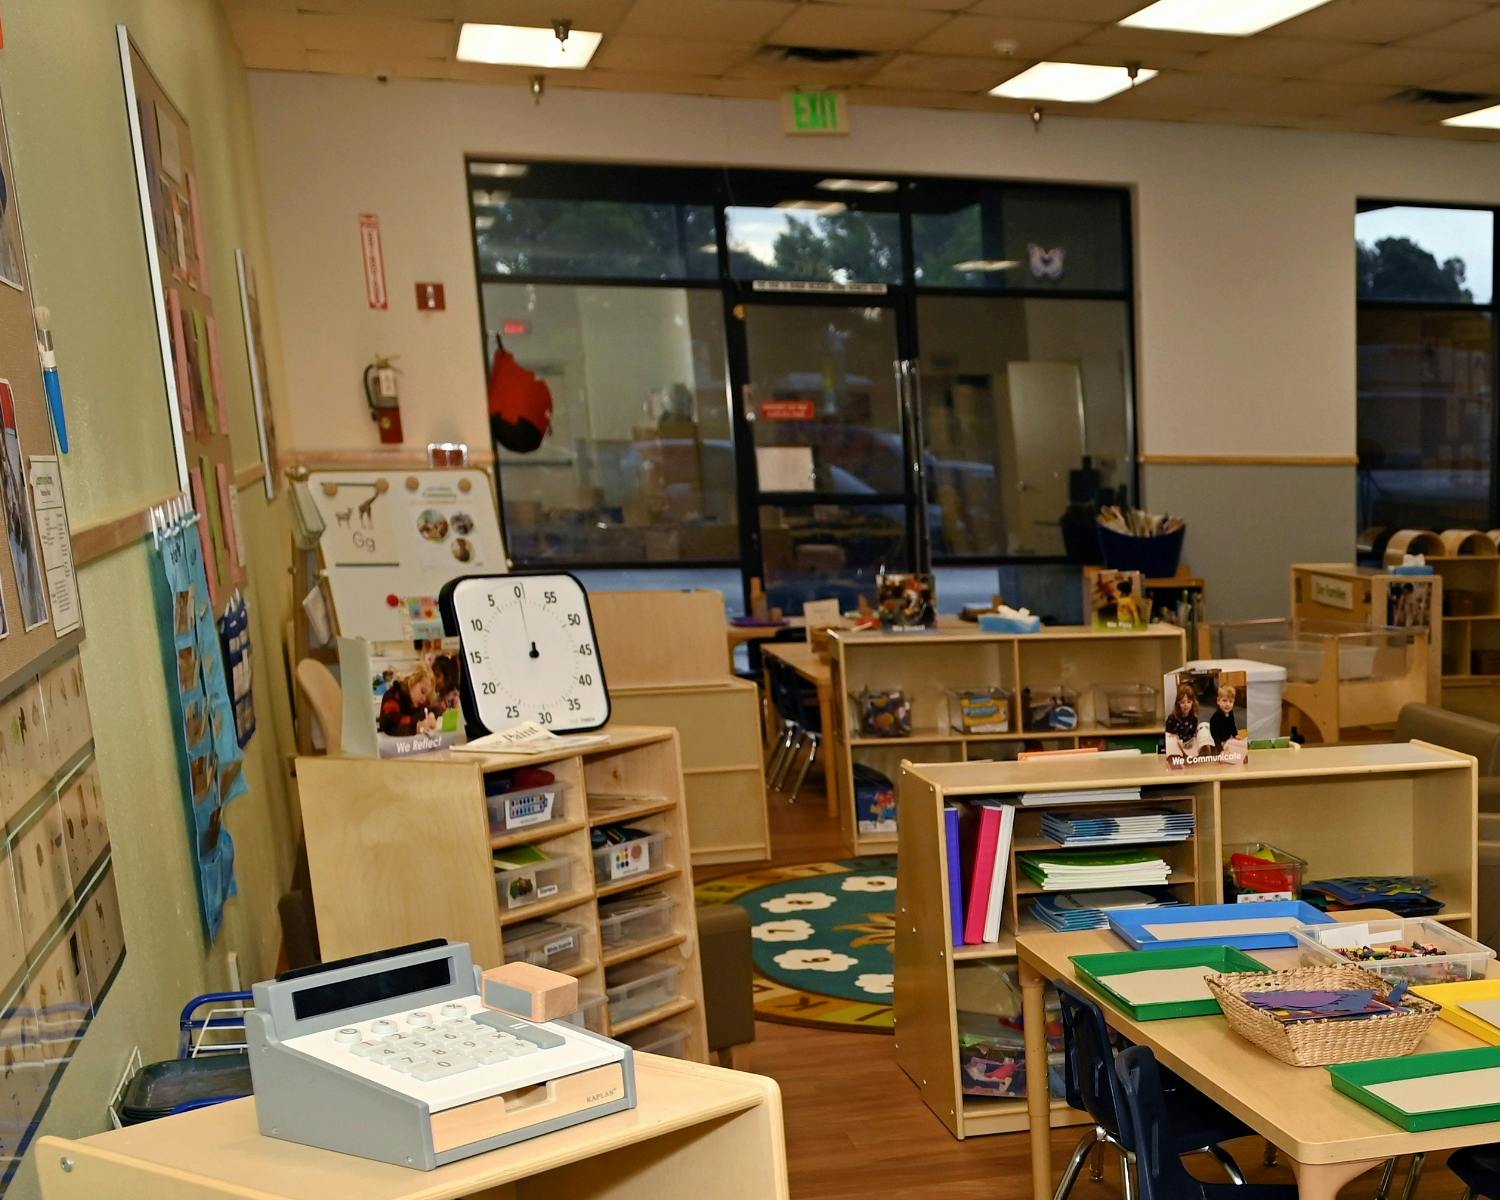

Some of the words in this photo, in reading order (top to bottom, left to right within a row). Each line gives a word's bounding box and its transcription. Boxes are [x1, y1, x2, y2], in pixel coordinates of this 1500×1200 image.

[792, 93, 838, 129] EXIT
[352, 531, 376, 553] Gg
[513, 585, 521, 599] 0
[544, 591, 557, 604] 55
[487, 594, 495, 608] 5
[470, 618, 483, 631] 10
[567, 613, 581, 626] 50
[579, 643, 592, 656] 45
[469, 651, 482, 664] 15
[578, 673, 592, 686] 40
[482, 682, 496, 695] 20
[567, 698, 581, 711] 35
[505, 705, 520, 718] 25
[538, 711, 553, 725] 30
[396, 741, 411, 753] We
[413, 736, 442, 752] Reflect
[1172, 756, 1185, 765] We
[1186, 752, 1242, 764] Communicate
[392, 1032, 407, 1040] 2
[444, 1032, 457, 1041] 6
